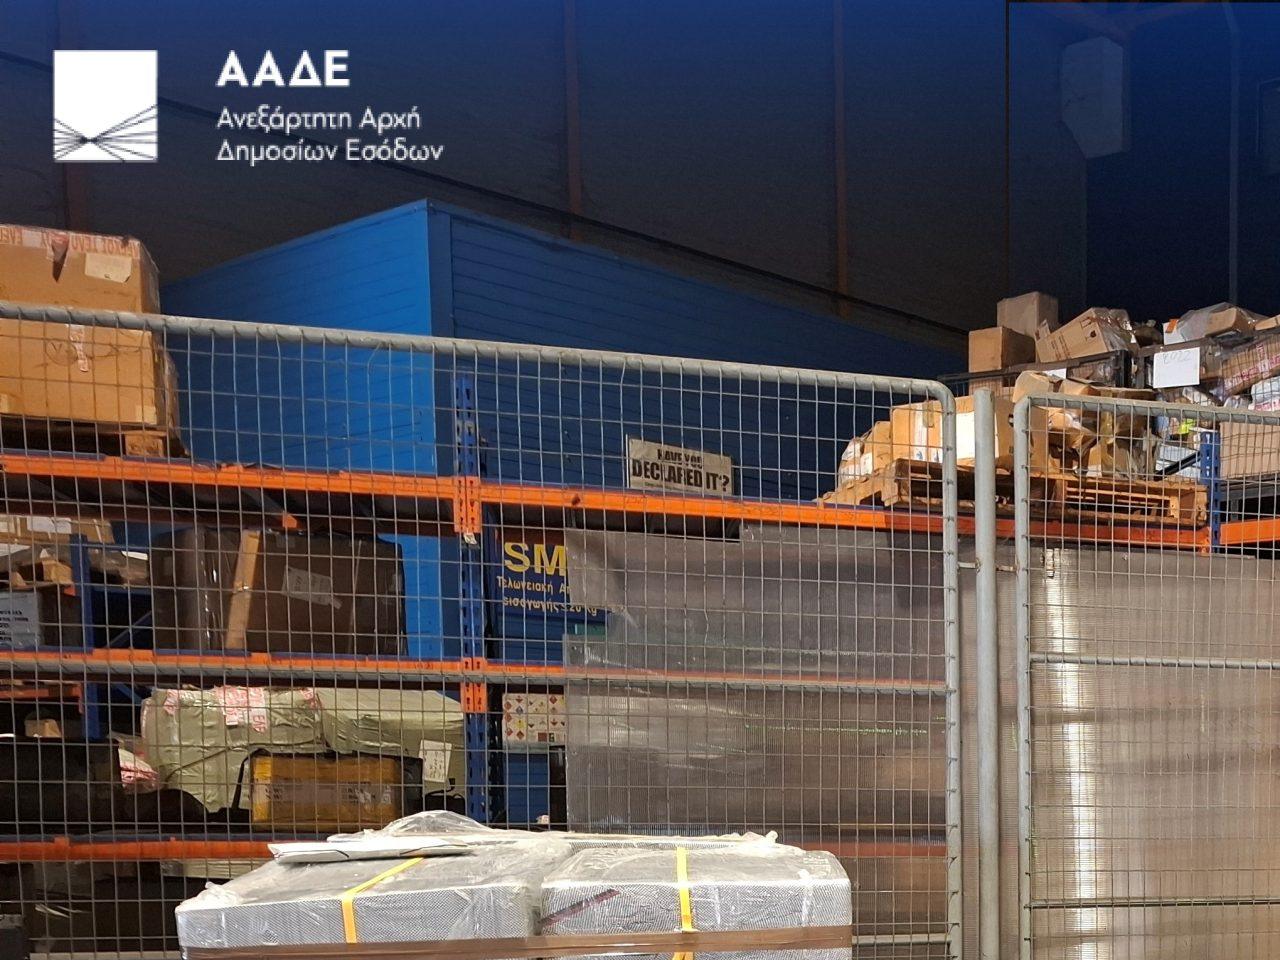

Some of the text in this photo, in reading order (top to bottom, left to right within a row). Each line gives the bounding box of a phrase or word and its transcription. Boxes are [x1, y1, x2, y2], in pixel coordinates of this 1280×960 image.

[656, 448, 703, 469] HAVE YOU
[632, 459, 702, 487] DECLARED
[504, 542, 567, 576] SM
